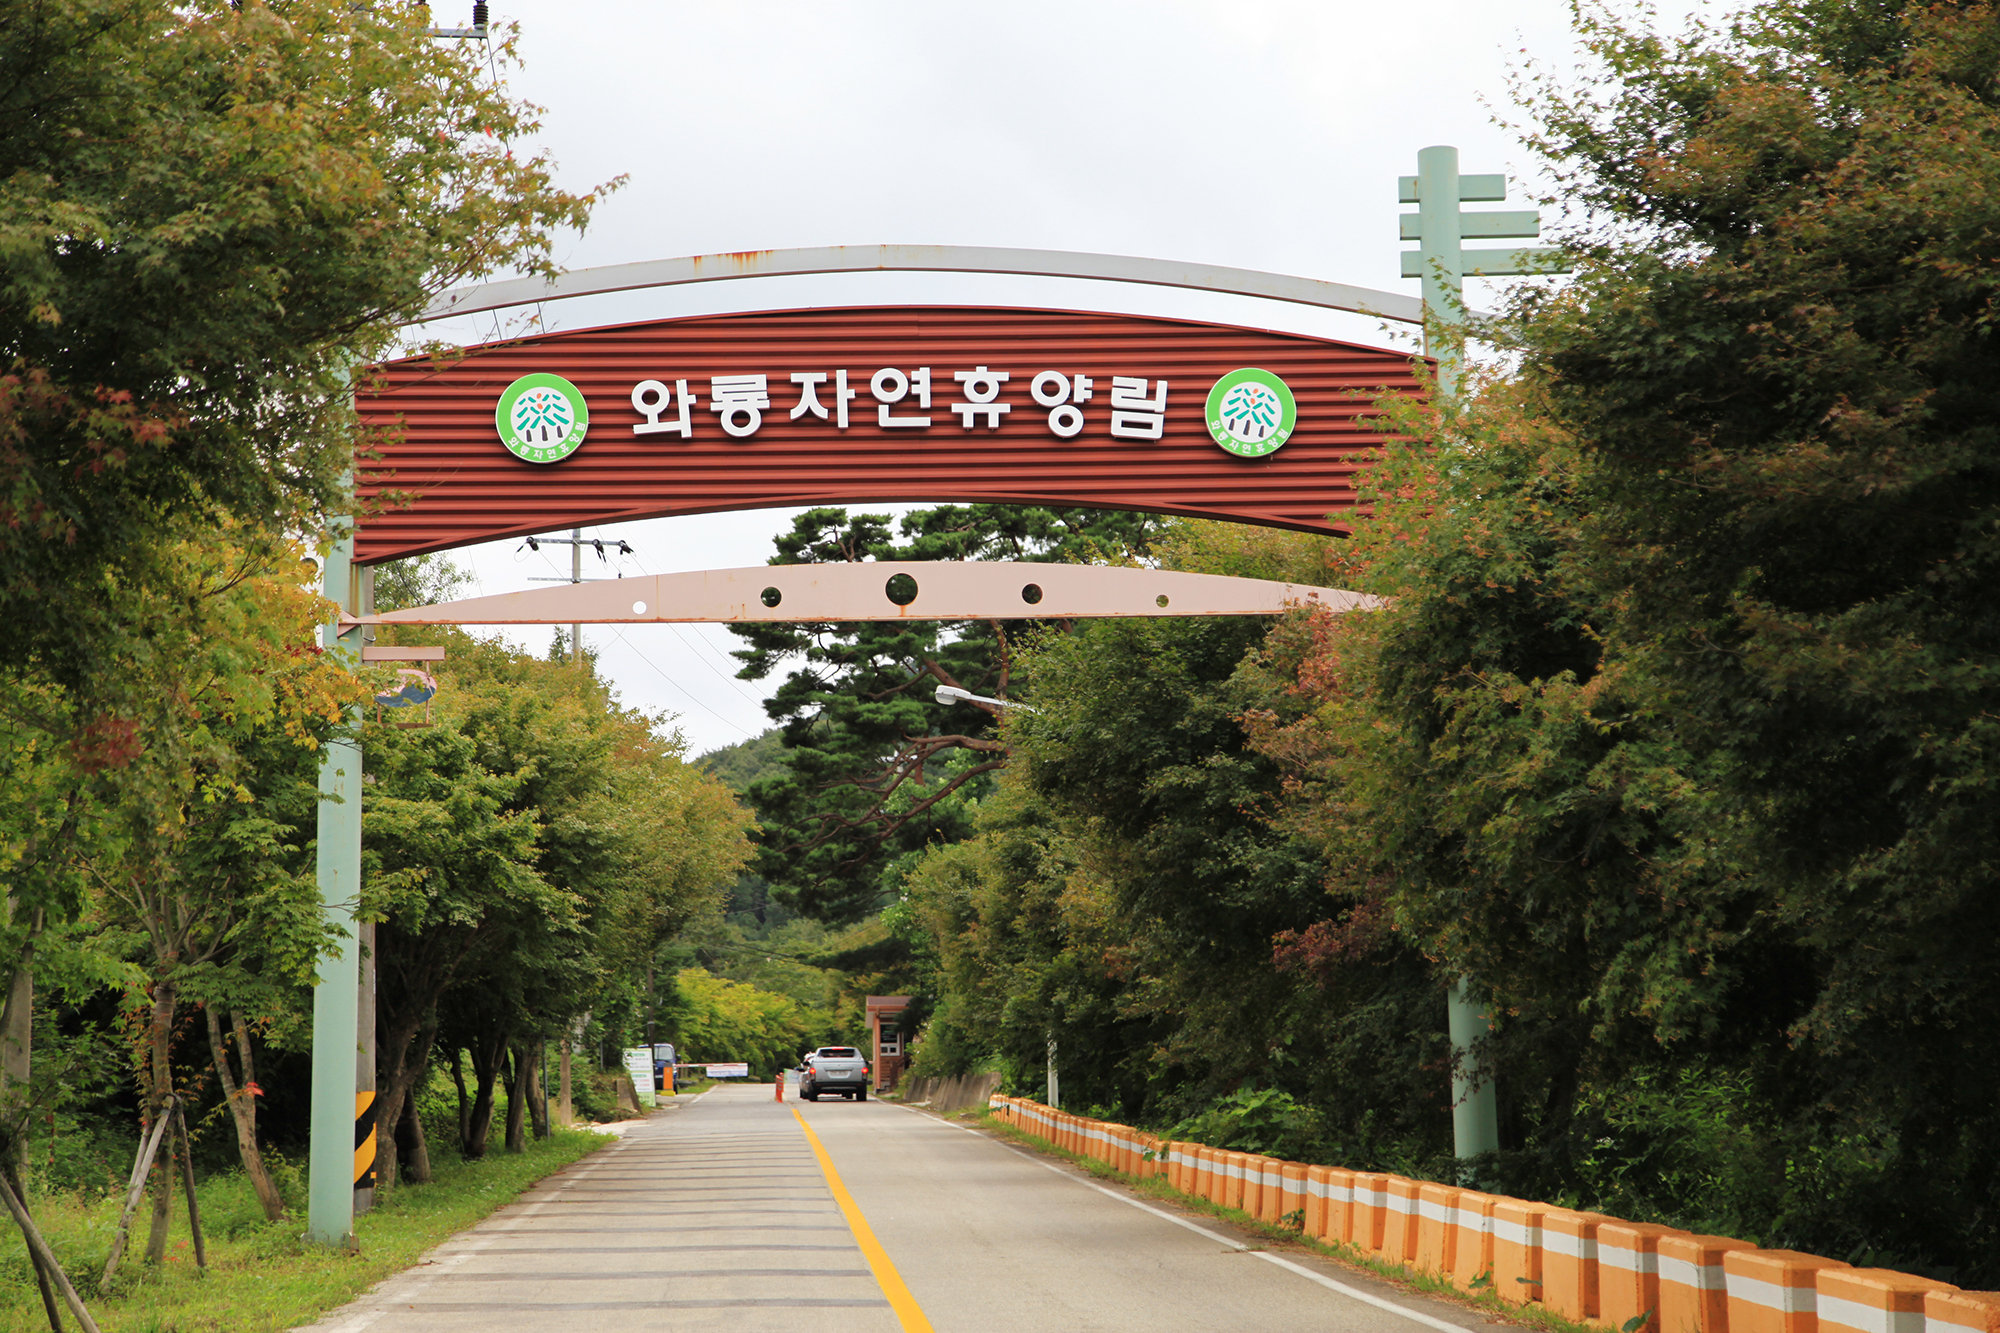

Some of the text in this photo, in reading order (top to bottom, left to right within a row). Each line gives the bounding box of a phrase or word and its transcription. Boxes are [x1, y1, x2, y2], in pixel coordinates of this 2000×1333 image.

[631, 366, 1169, 441] 와룡자연휴양림
[508, 422, 586, 460] 와룡자연휴양림
[1210, 420, 1289, 455] 와룡자연휴양림
